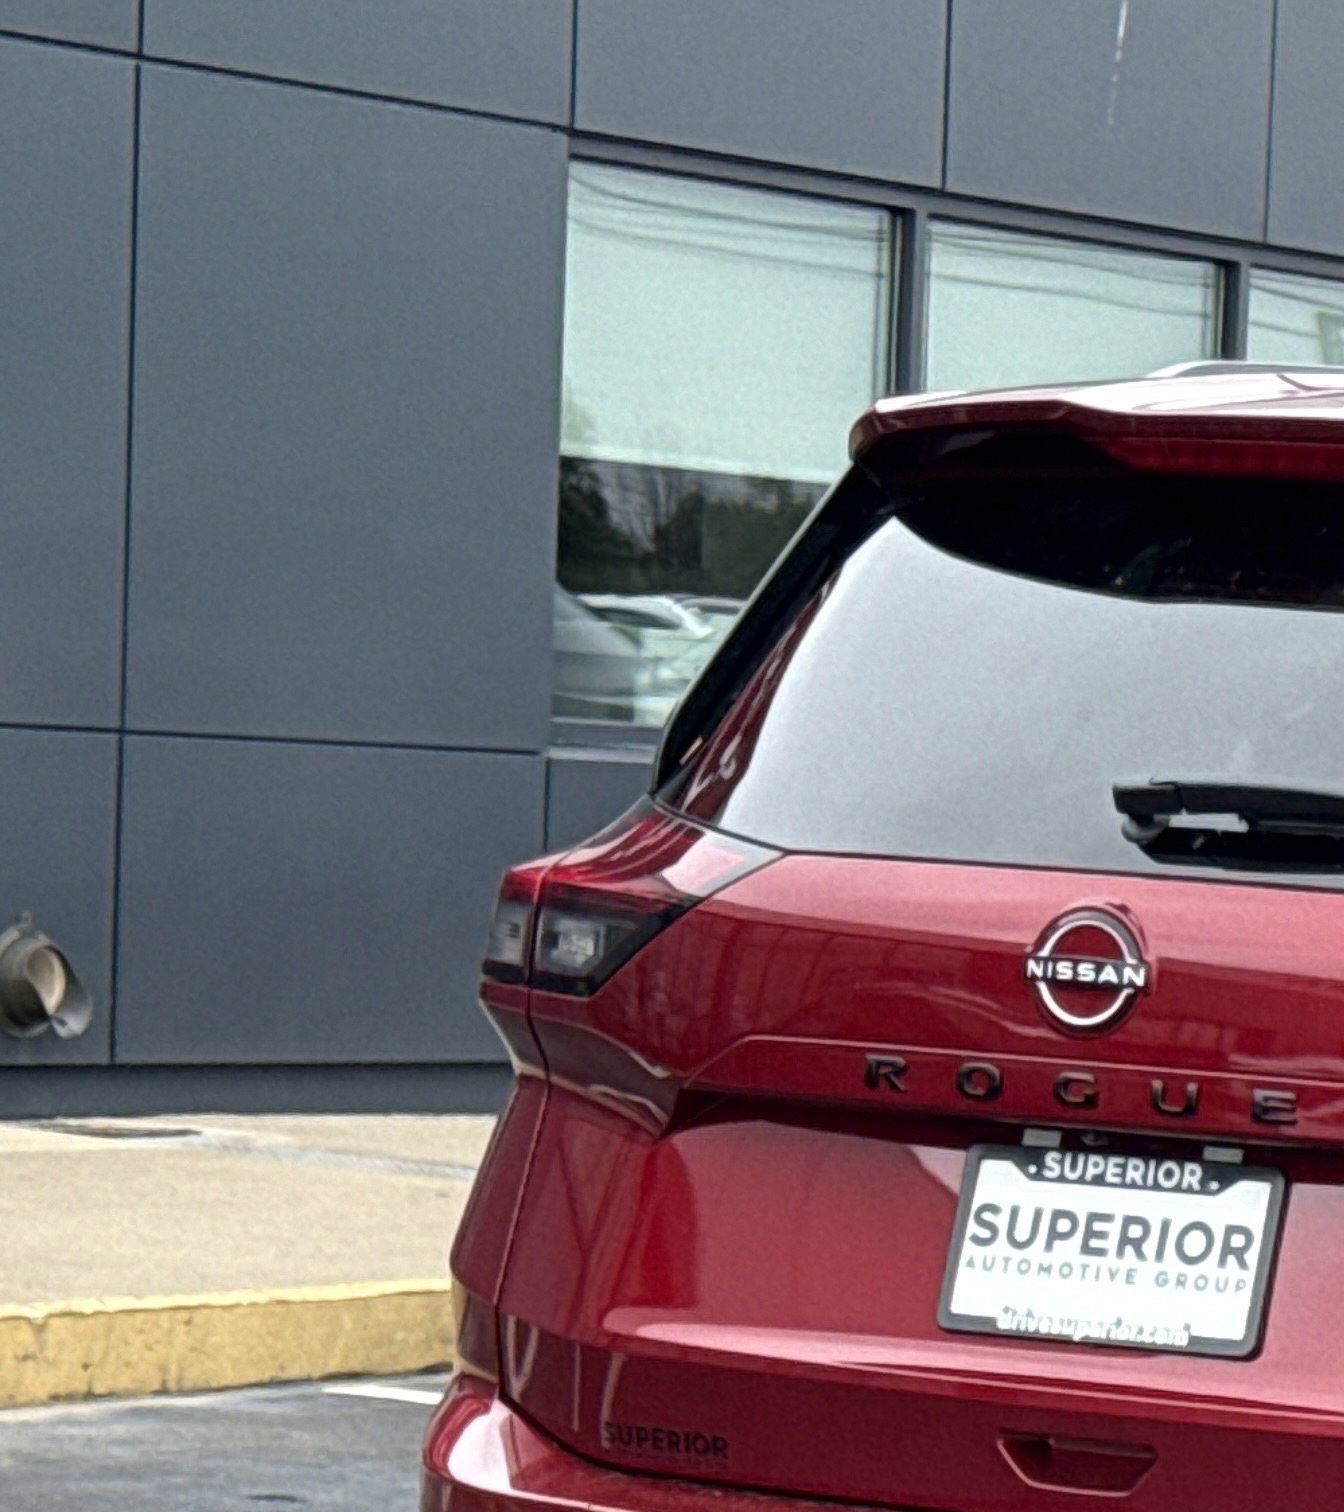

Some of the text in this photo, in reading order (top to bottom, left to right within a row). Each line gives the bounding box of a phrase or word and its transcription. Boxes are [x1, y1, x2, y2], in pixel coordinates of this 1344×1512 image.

[1026, 958, 1146, 987] NISSAN
[865, 1054, 1298, 1123] ROGUE
[1042, 1151, 1204, 1191] SUPERIOR
[968, 1203, 1255, 1271] SUPERIOR
[964, 1255, 1247, 1294] AUTOMOTIVE GROUP
[604, 1421, 728, 1459] SUPERIOR
